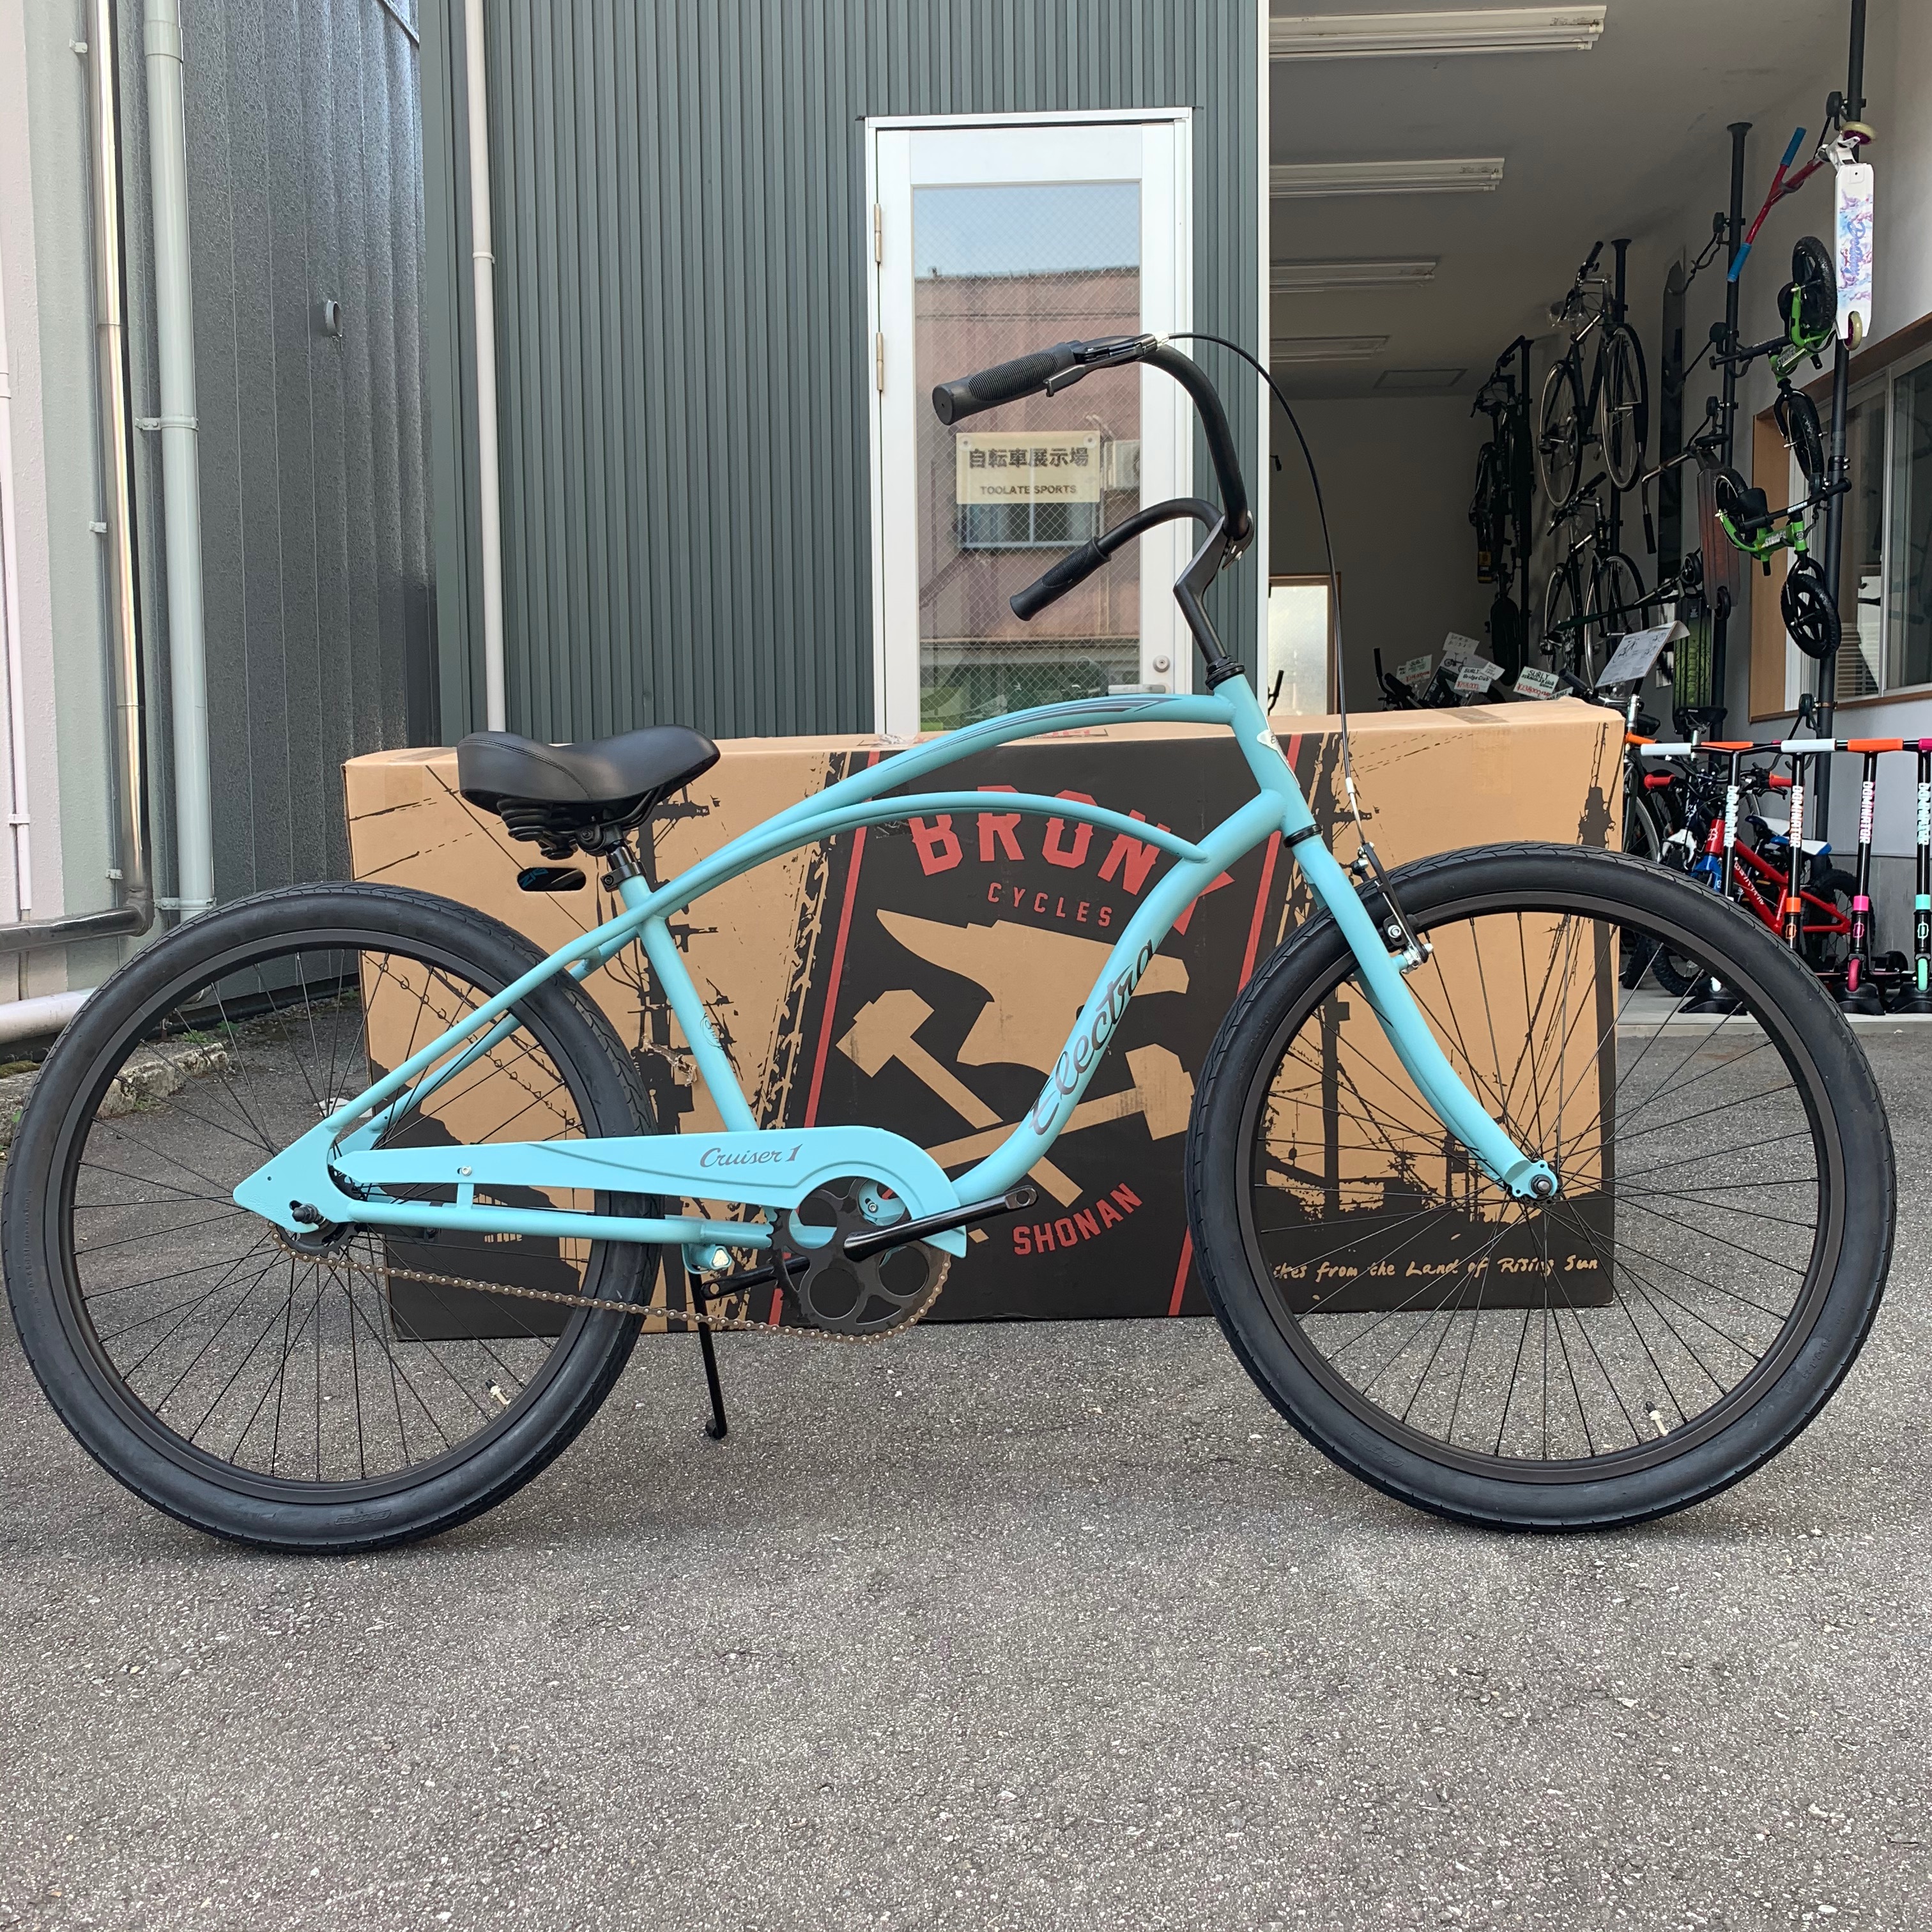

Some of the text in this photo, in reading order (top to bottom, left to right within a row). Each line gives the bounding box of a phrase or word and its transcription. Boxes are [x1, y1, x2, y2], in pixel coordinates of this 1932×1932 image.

[969, 448, 1089, 468] 自転車展示場
[981, 485, 1077, 494] TOOLATE SPORTS
[1528, 670, 1550, 680] SURLY
[1790, 785, 1804, 848] DOMINATOR
[1860, 781, 1874, 844] DOMINATOR
[988, 882, 1112, 927] CYCLES
[1029, 937, 1162, 1135] Electra
[700, 1144, 803, 1168] Cruiser 1
[1013, 1183, 1143, 1255] SHONAN
[1273, 1254, 1597, 1282] ikes from the Land of Rising Sun
